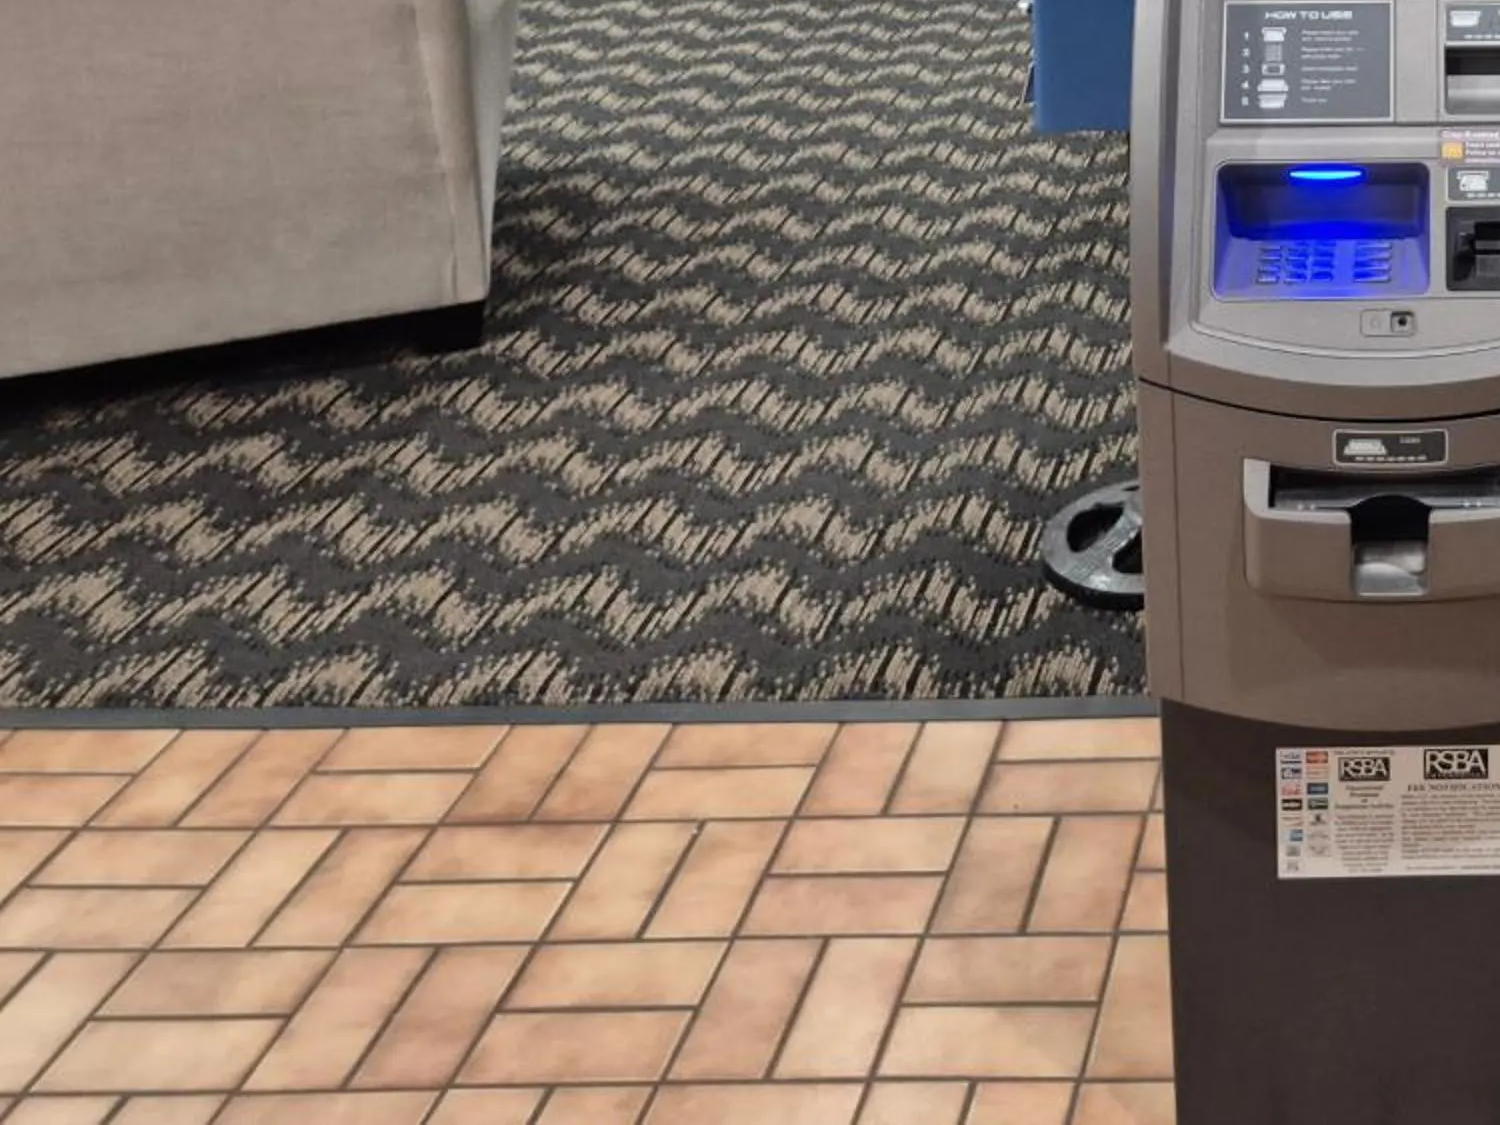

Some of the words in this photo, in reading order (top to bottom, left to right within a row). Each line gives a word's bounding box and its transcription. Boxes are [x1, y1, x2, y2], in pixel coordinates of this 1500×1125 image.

[1299, 11, 1319, 20] TO
[1340, 758, 1388, 776] RSBA
[1425, 750, 1485, 774] RSBA
